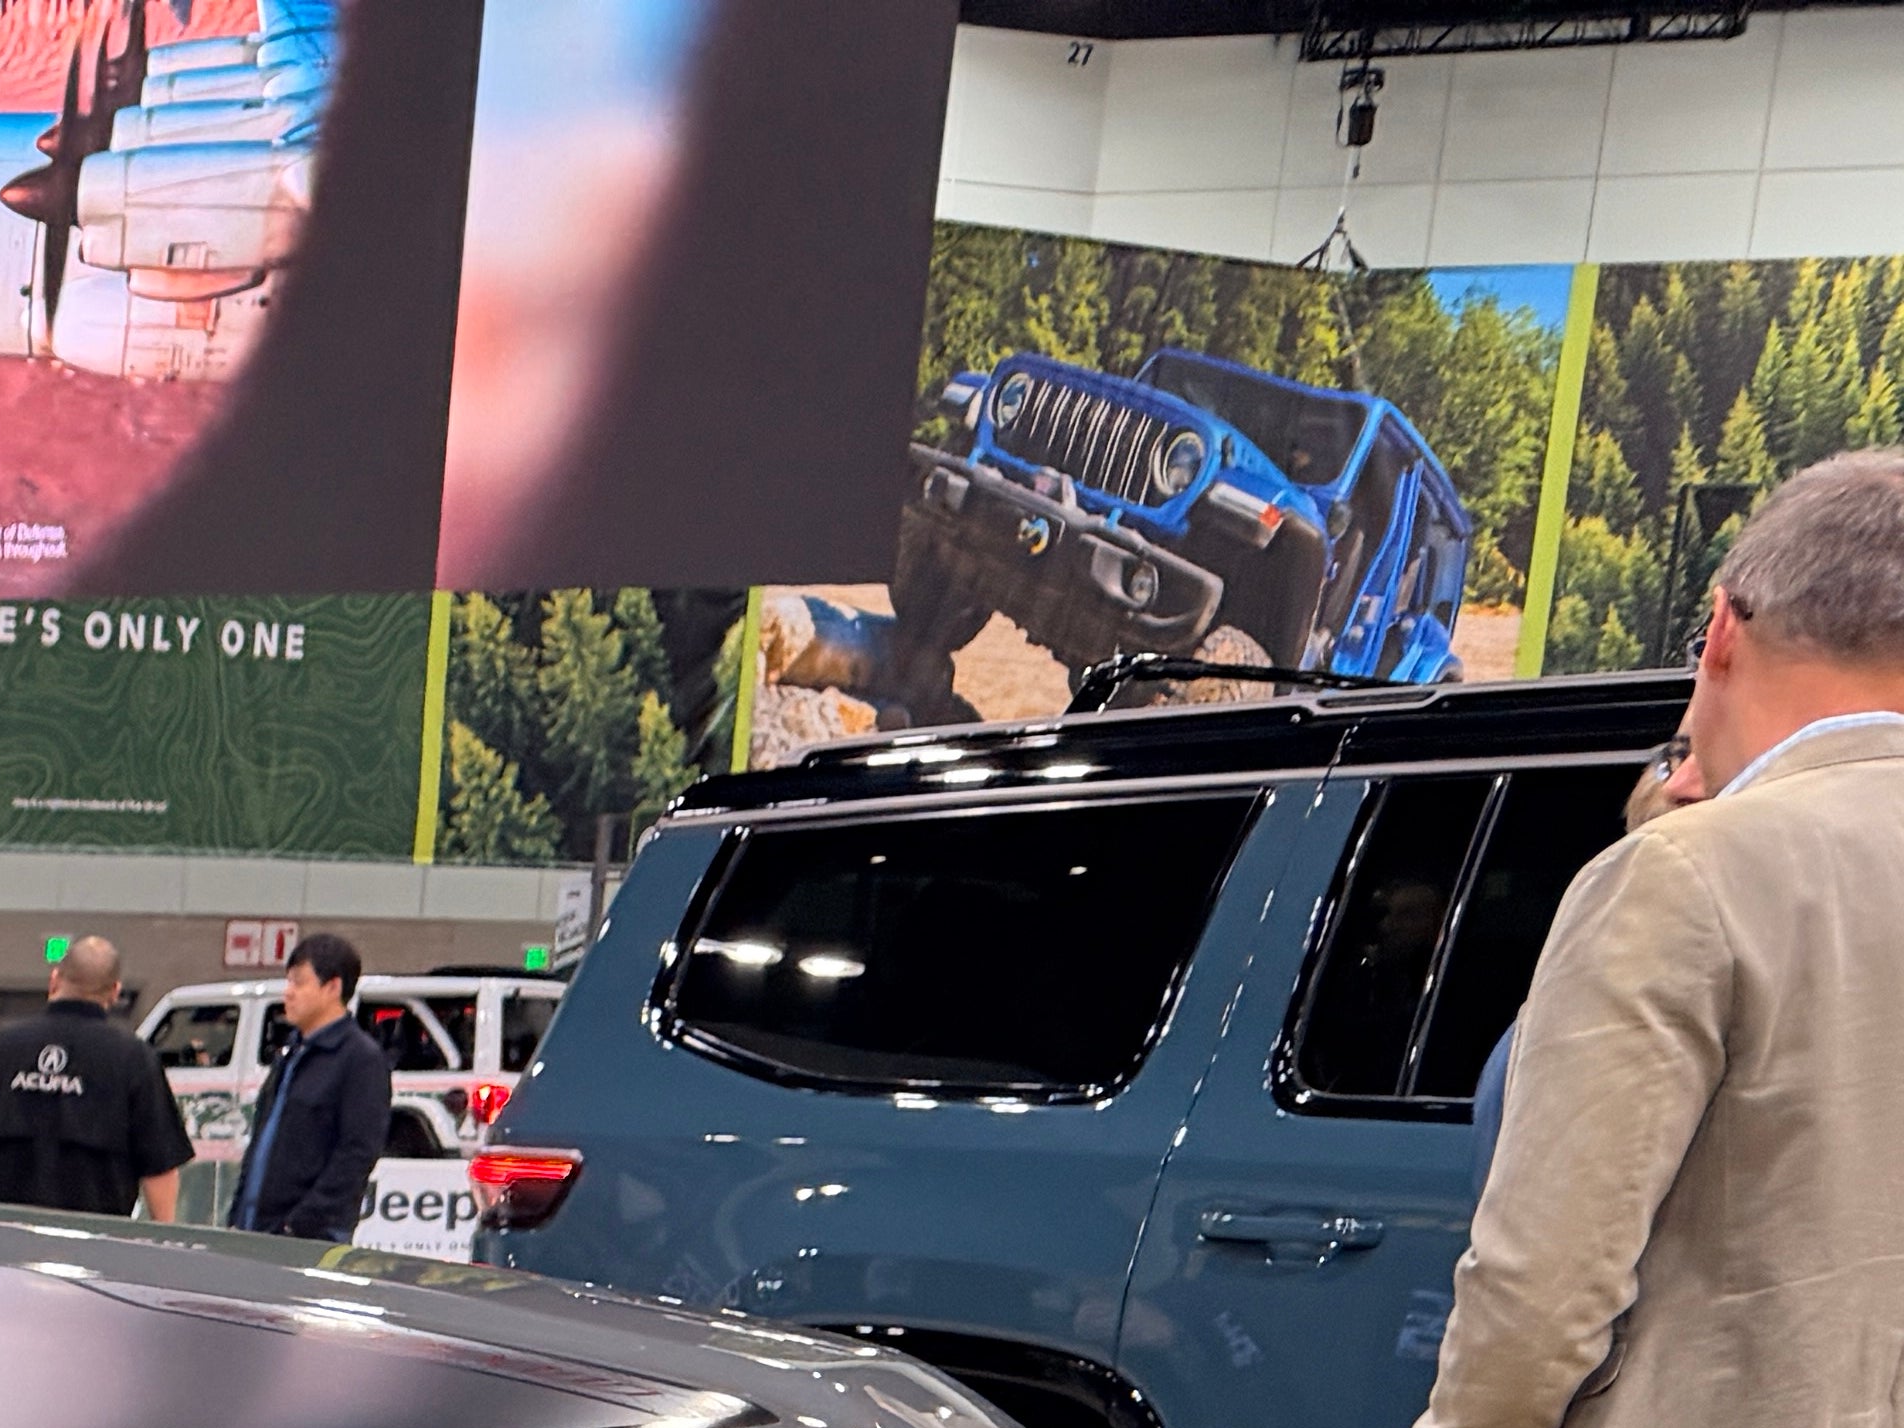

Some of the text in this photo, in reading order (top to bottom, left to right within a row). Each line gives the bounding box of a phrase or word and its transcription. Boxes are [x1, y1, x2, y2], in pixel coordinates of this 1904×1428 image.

[84, 610, 200, 653] ONLY
[221, 620, 307, 660] ONE
[10, 1071, 84, 1096] ACURA
[359, 1181, 478, 1230] Jeep
